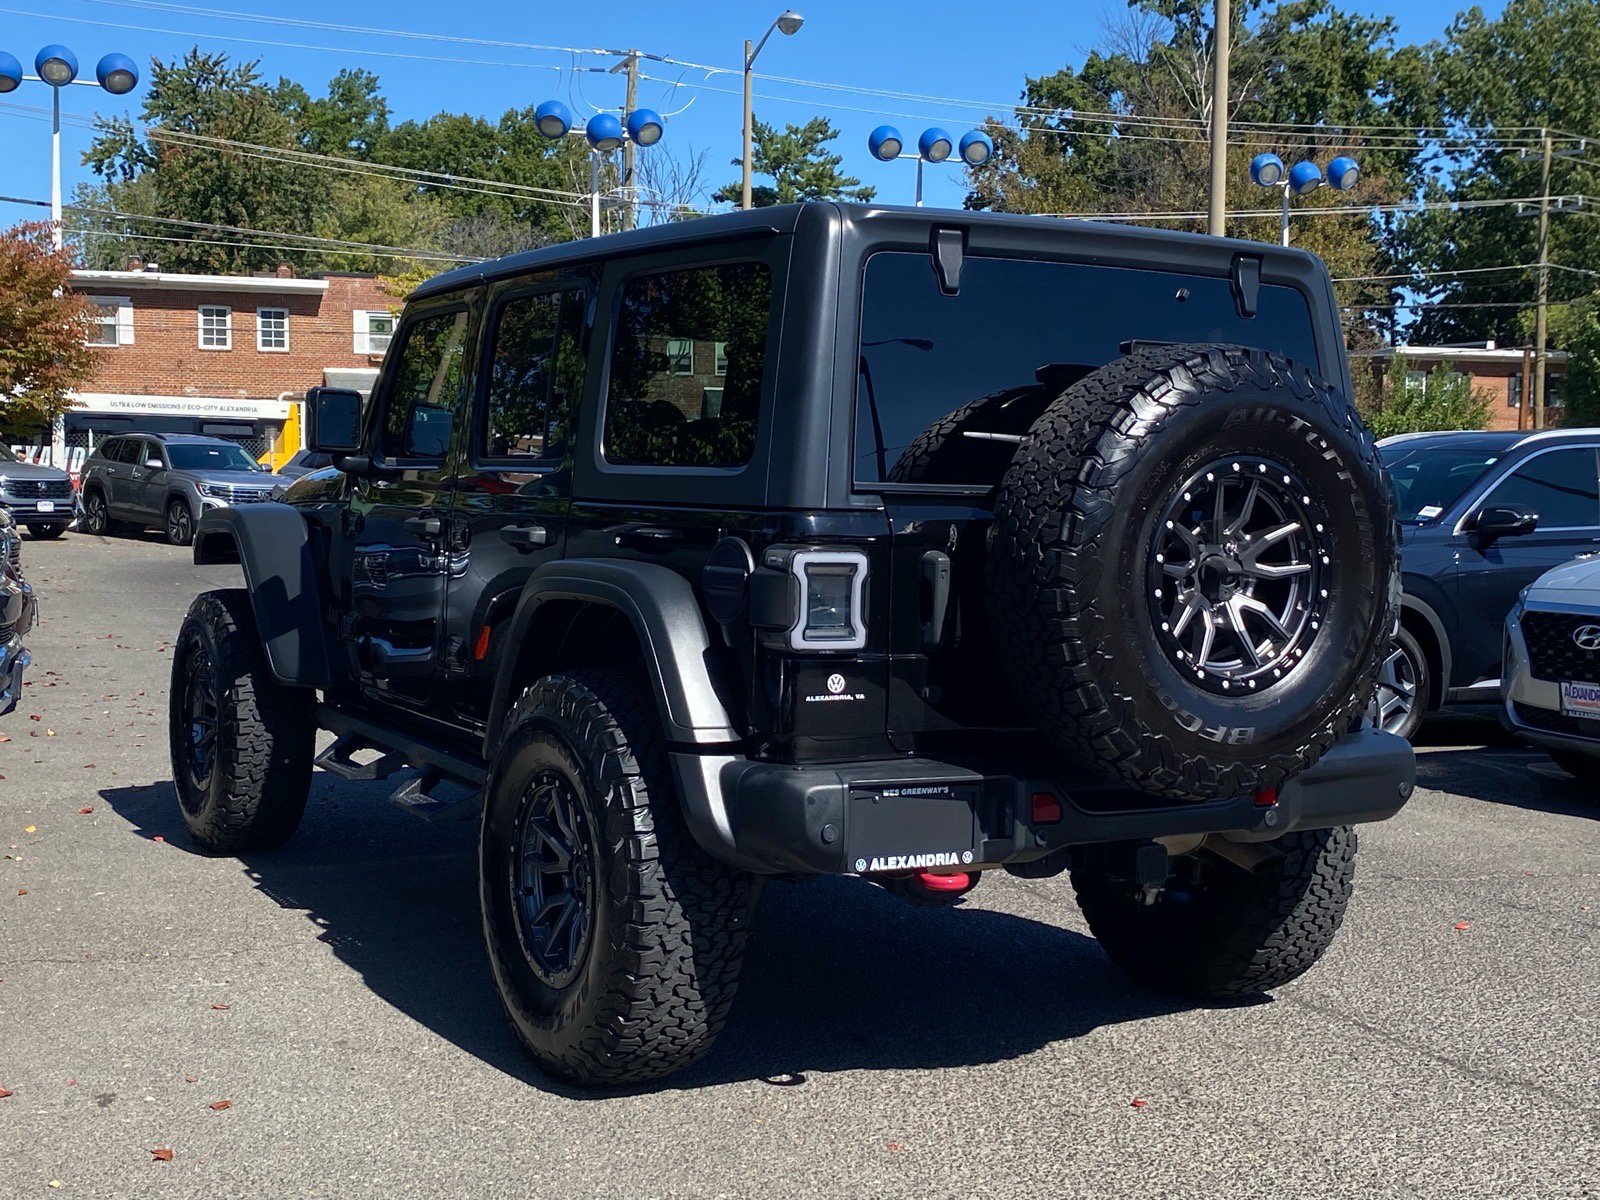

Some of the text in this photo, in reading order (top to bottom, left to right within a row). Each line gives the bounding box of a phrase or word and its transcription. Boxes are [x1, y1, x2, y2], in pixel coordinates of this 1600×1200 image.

[147, 402, 181, 410] EMISSIONS
[219, 405, 258, 413] ALEXANDRIA
[805, 694, 854, 702] ALEXANDRIA,
[883, 786, 949, 797] WES GREENWAY'S
[869, 852, 960, 871] ALEXANDRIA
